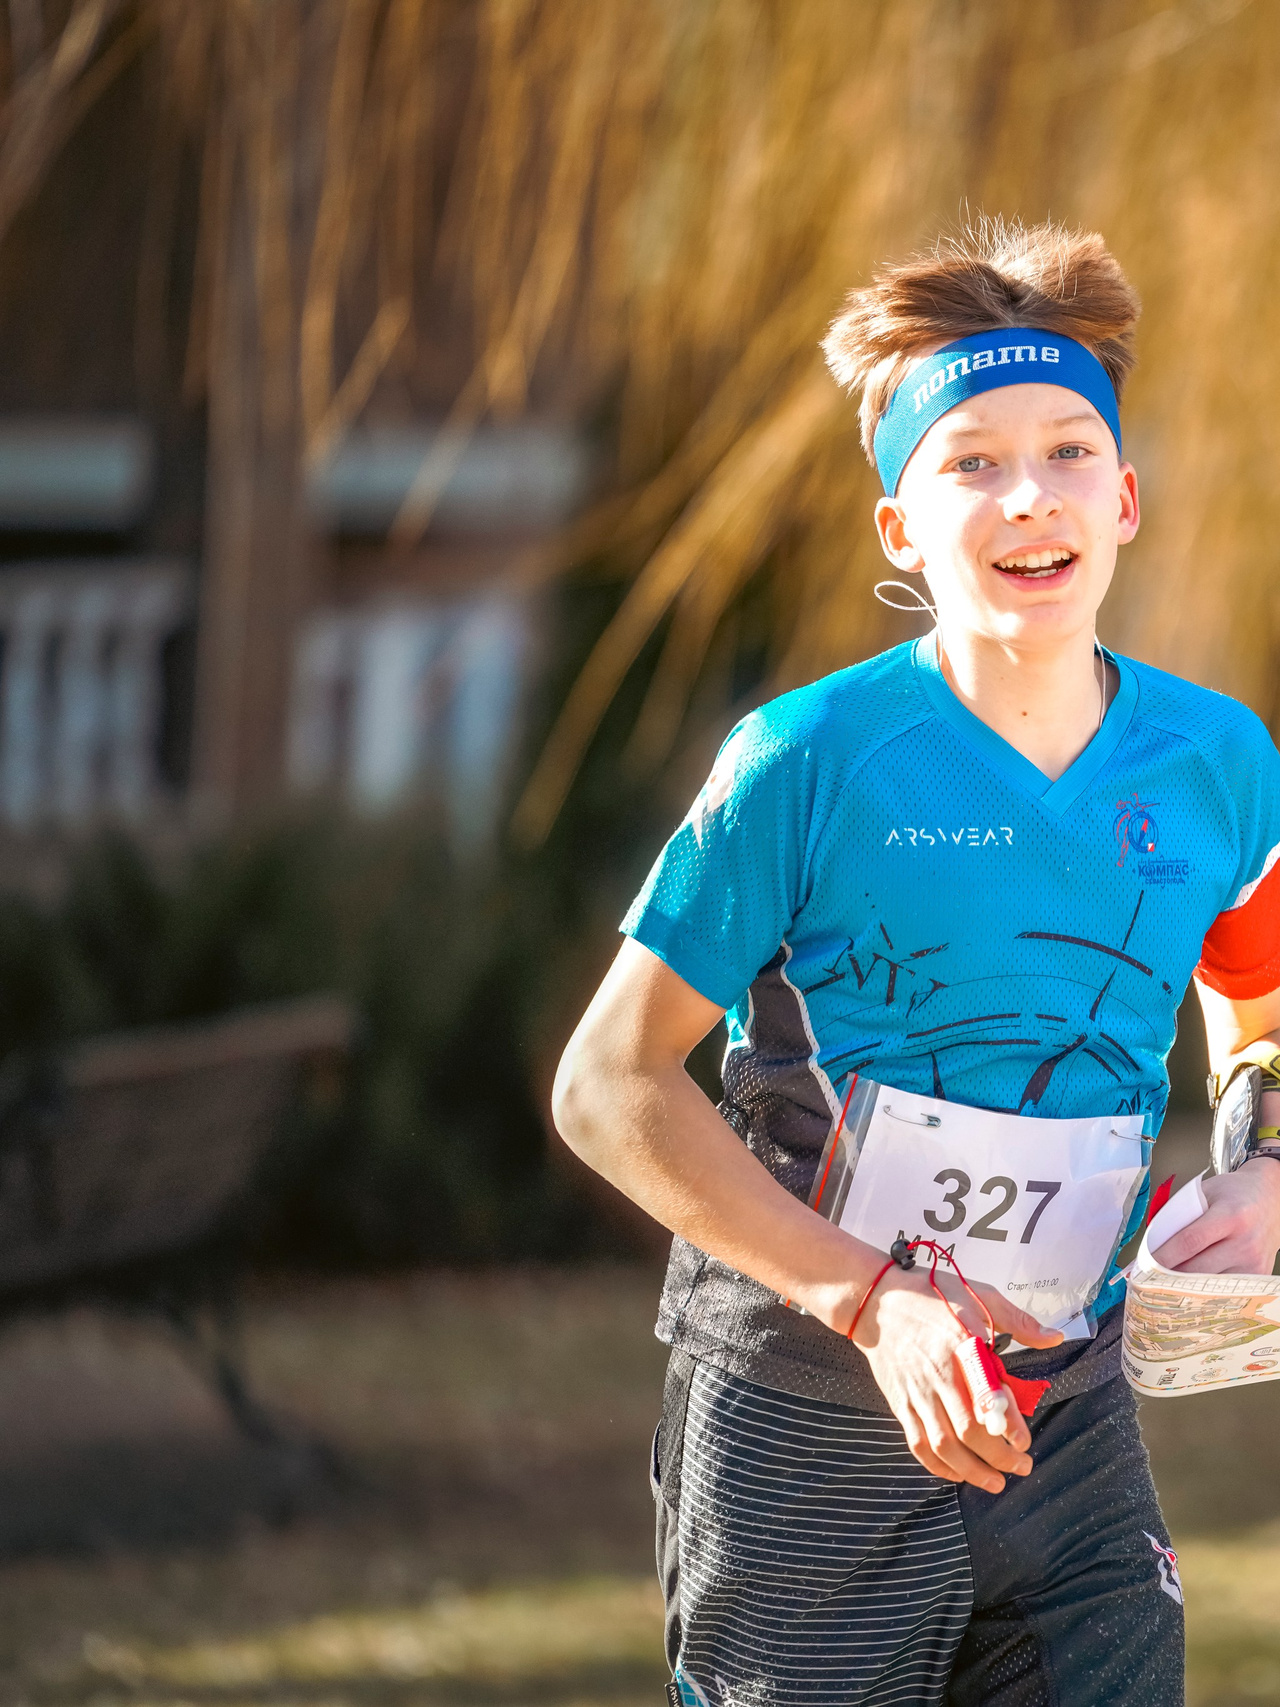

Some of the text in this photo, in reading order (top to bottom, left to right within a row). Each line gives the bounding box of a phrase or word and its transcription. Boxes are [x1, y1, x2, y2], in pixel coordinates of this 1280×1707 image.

[913, 346, 1060, 413] noname
[885, 827, 1014, 846] ARSWEAR
[1137, 864, 1189, 877] КОМПАС
[923, 1168, 1062, 1244] 327
